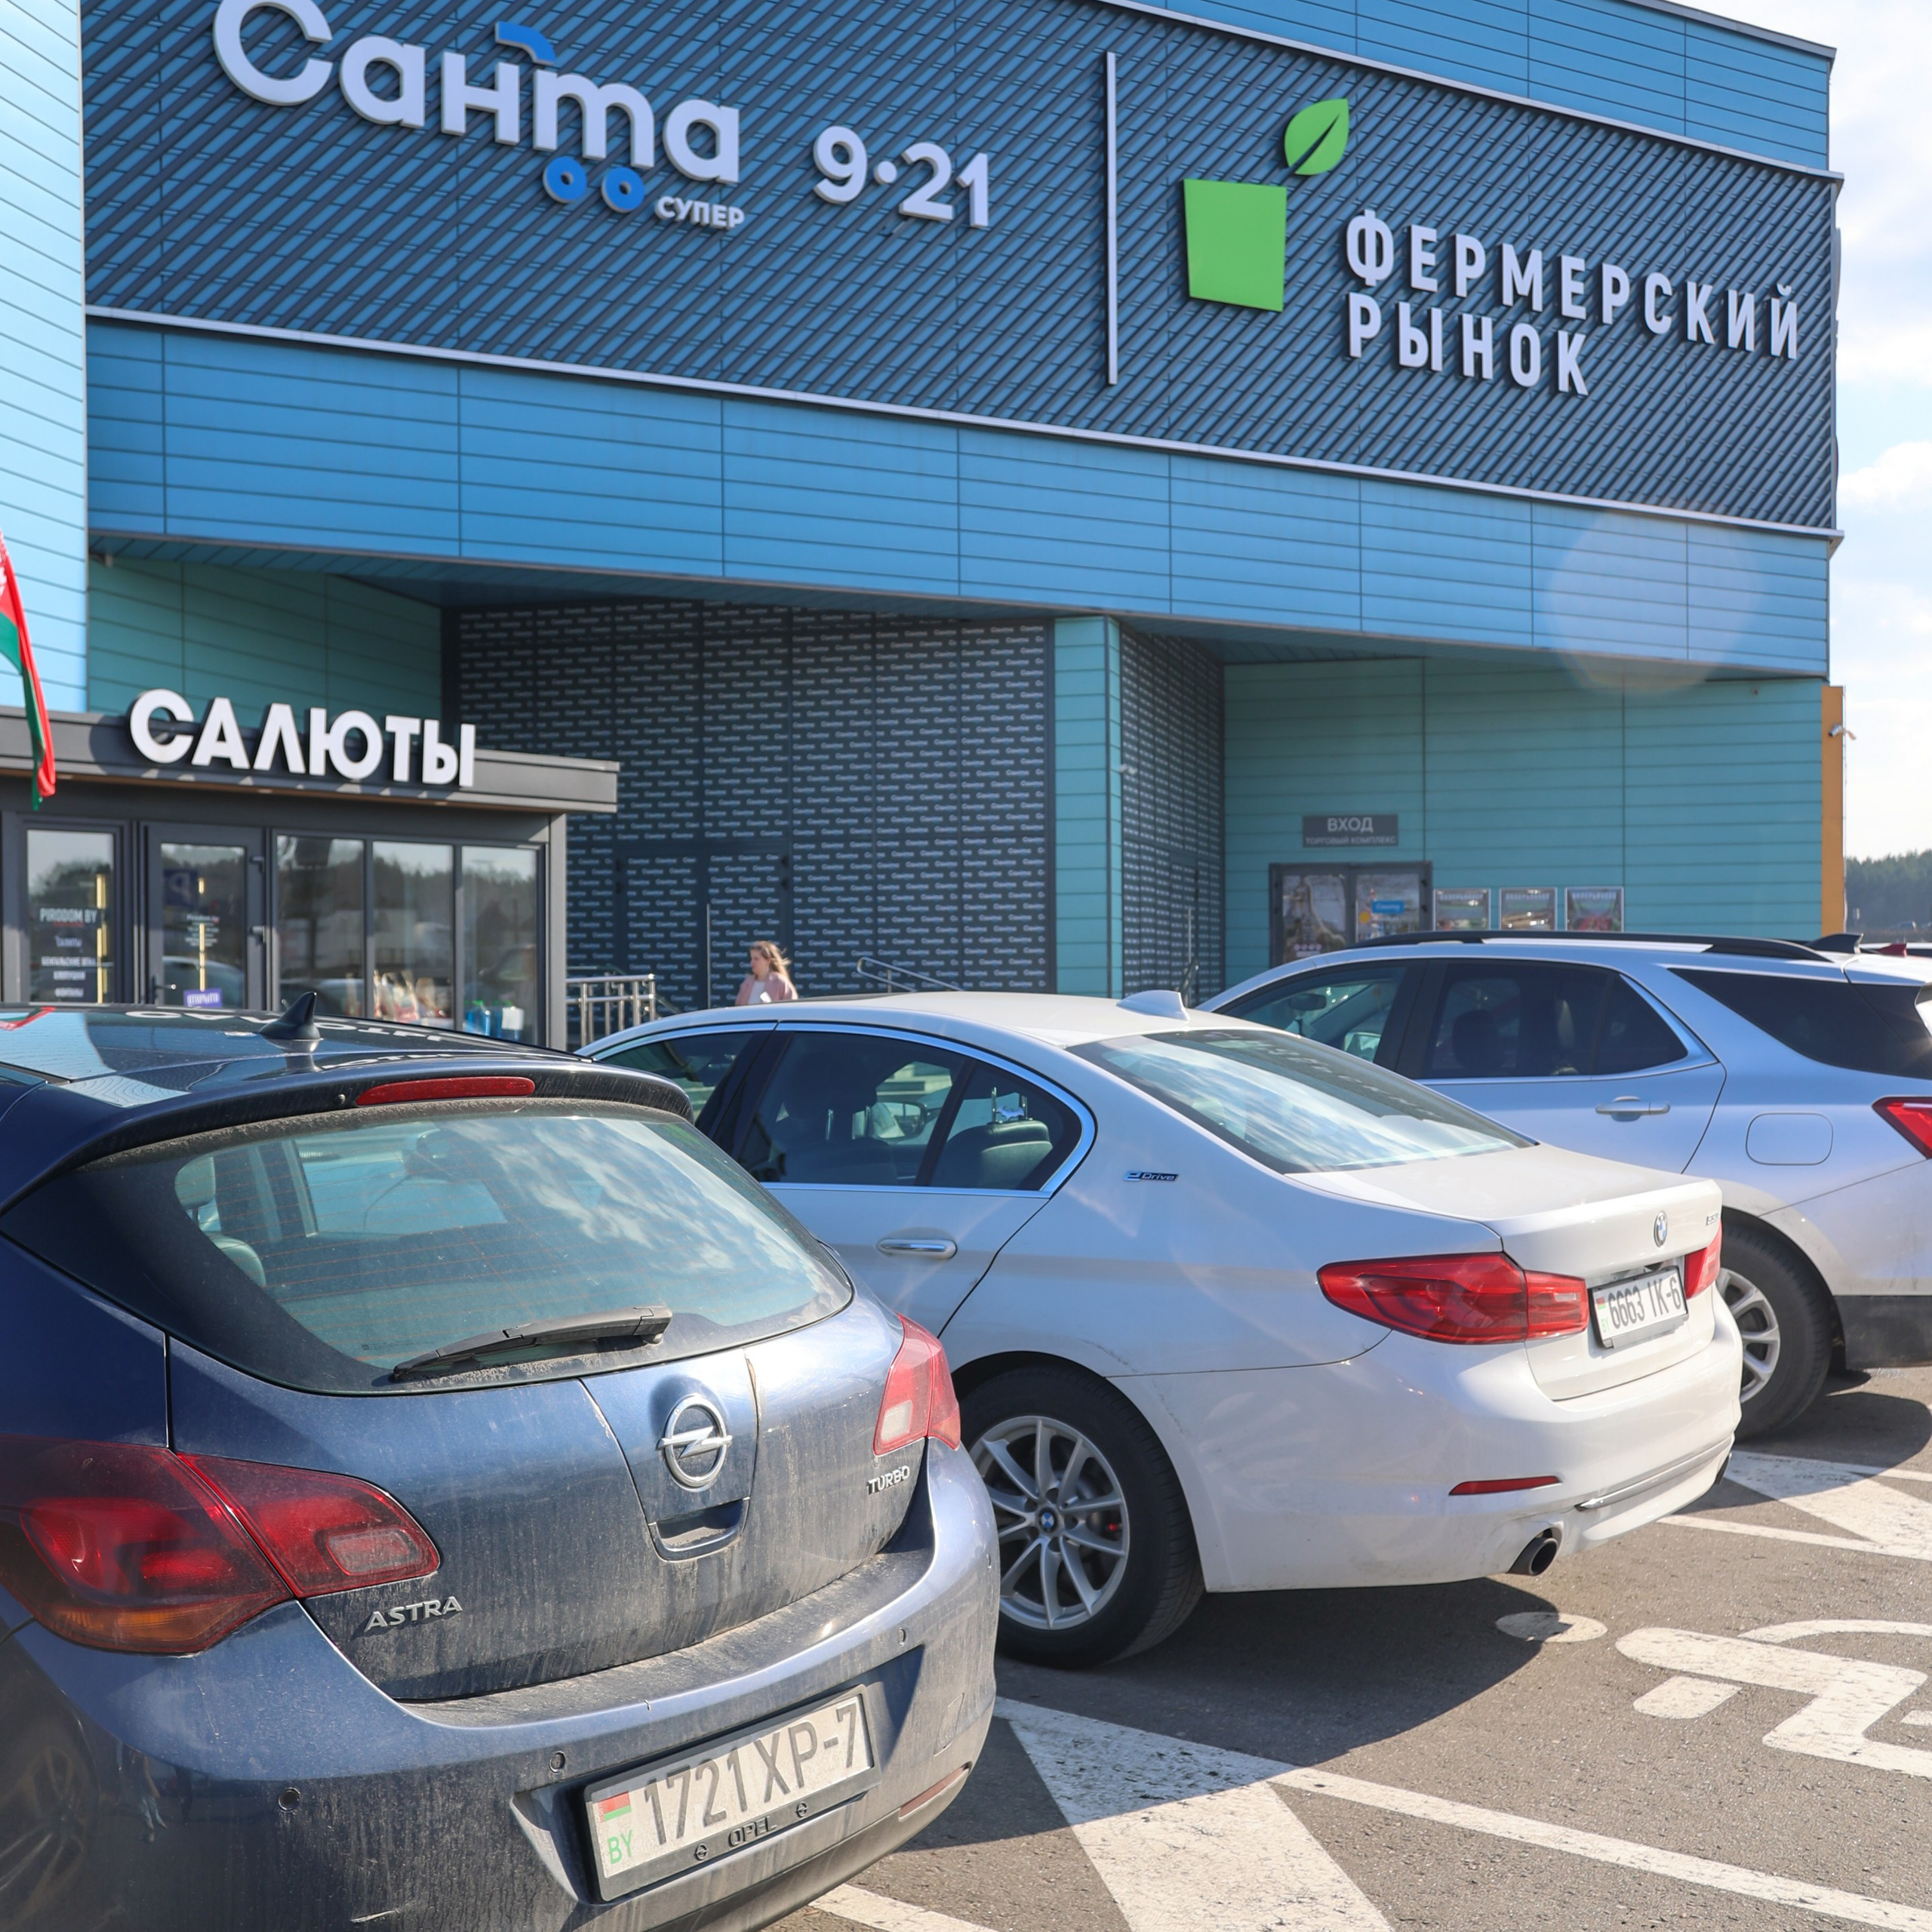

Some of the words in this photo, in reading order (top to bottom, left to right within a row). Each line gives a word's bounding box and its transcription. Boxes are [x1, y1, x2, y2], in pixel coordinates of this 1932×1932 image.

[213, 0, 741, 184] Санта
[654, 193, 746, 229] СУПЕР
[1346, 209, 1800, 360] ФЕРМЕРСКИЙ
[1347, 291, 1589, 397] РЫНОК
[129, 688, 476, 788] САЛЮТЫ
[1305, 834, 1349, 845] ТОРГОВЫЙ
[1350, 834, 1397, 844] КОМПЛЕКС
[1327, 817, 1374, 833] ВХОД
[866, 1465, 911, 1495] TURBO
[364, 1596, 463, 1632] ASTRA
[607, 1829, 633, 1865] BY
[728, 1815, 778, 1847] OPEL
